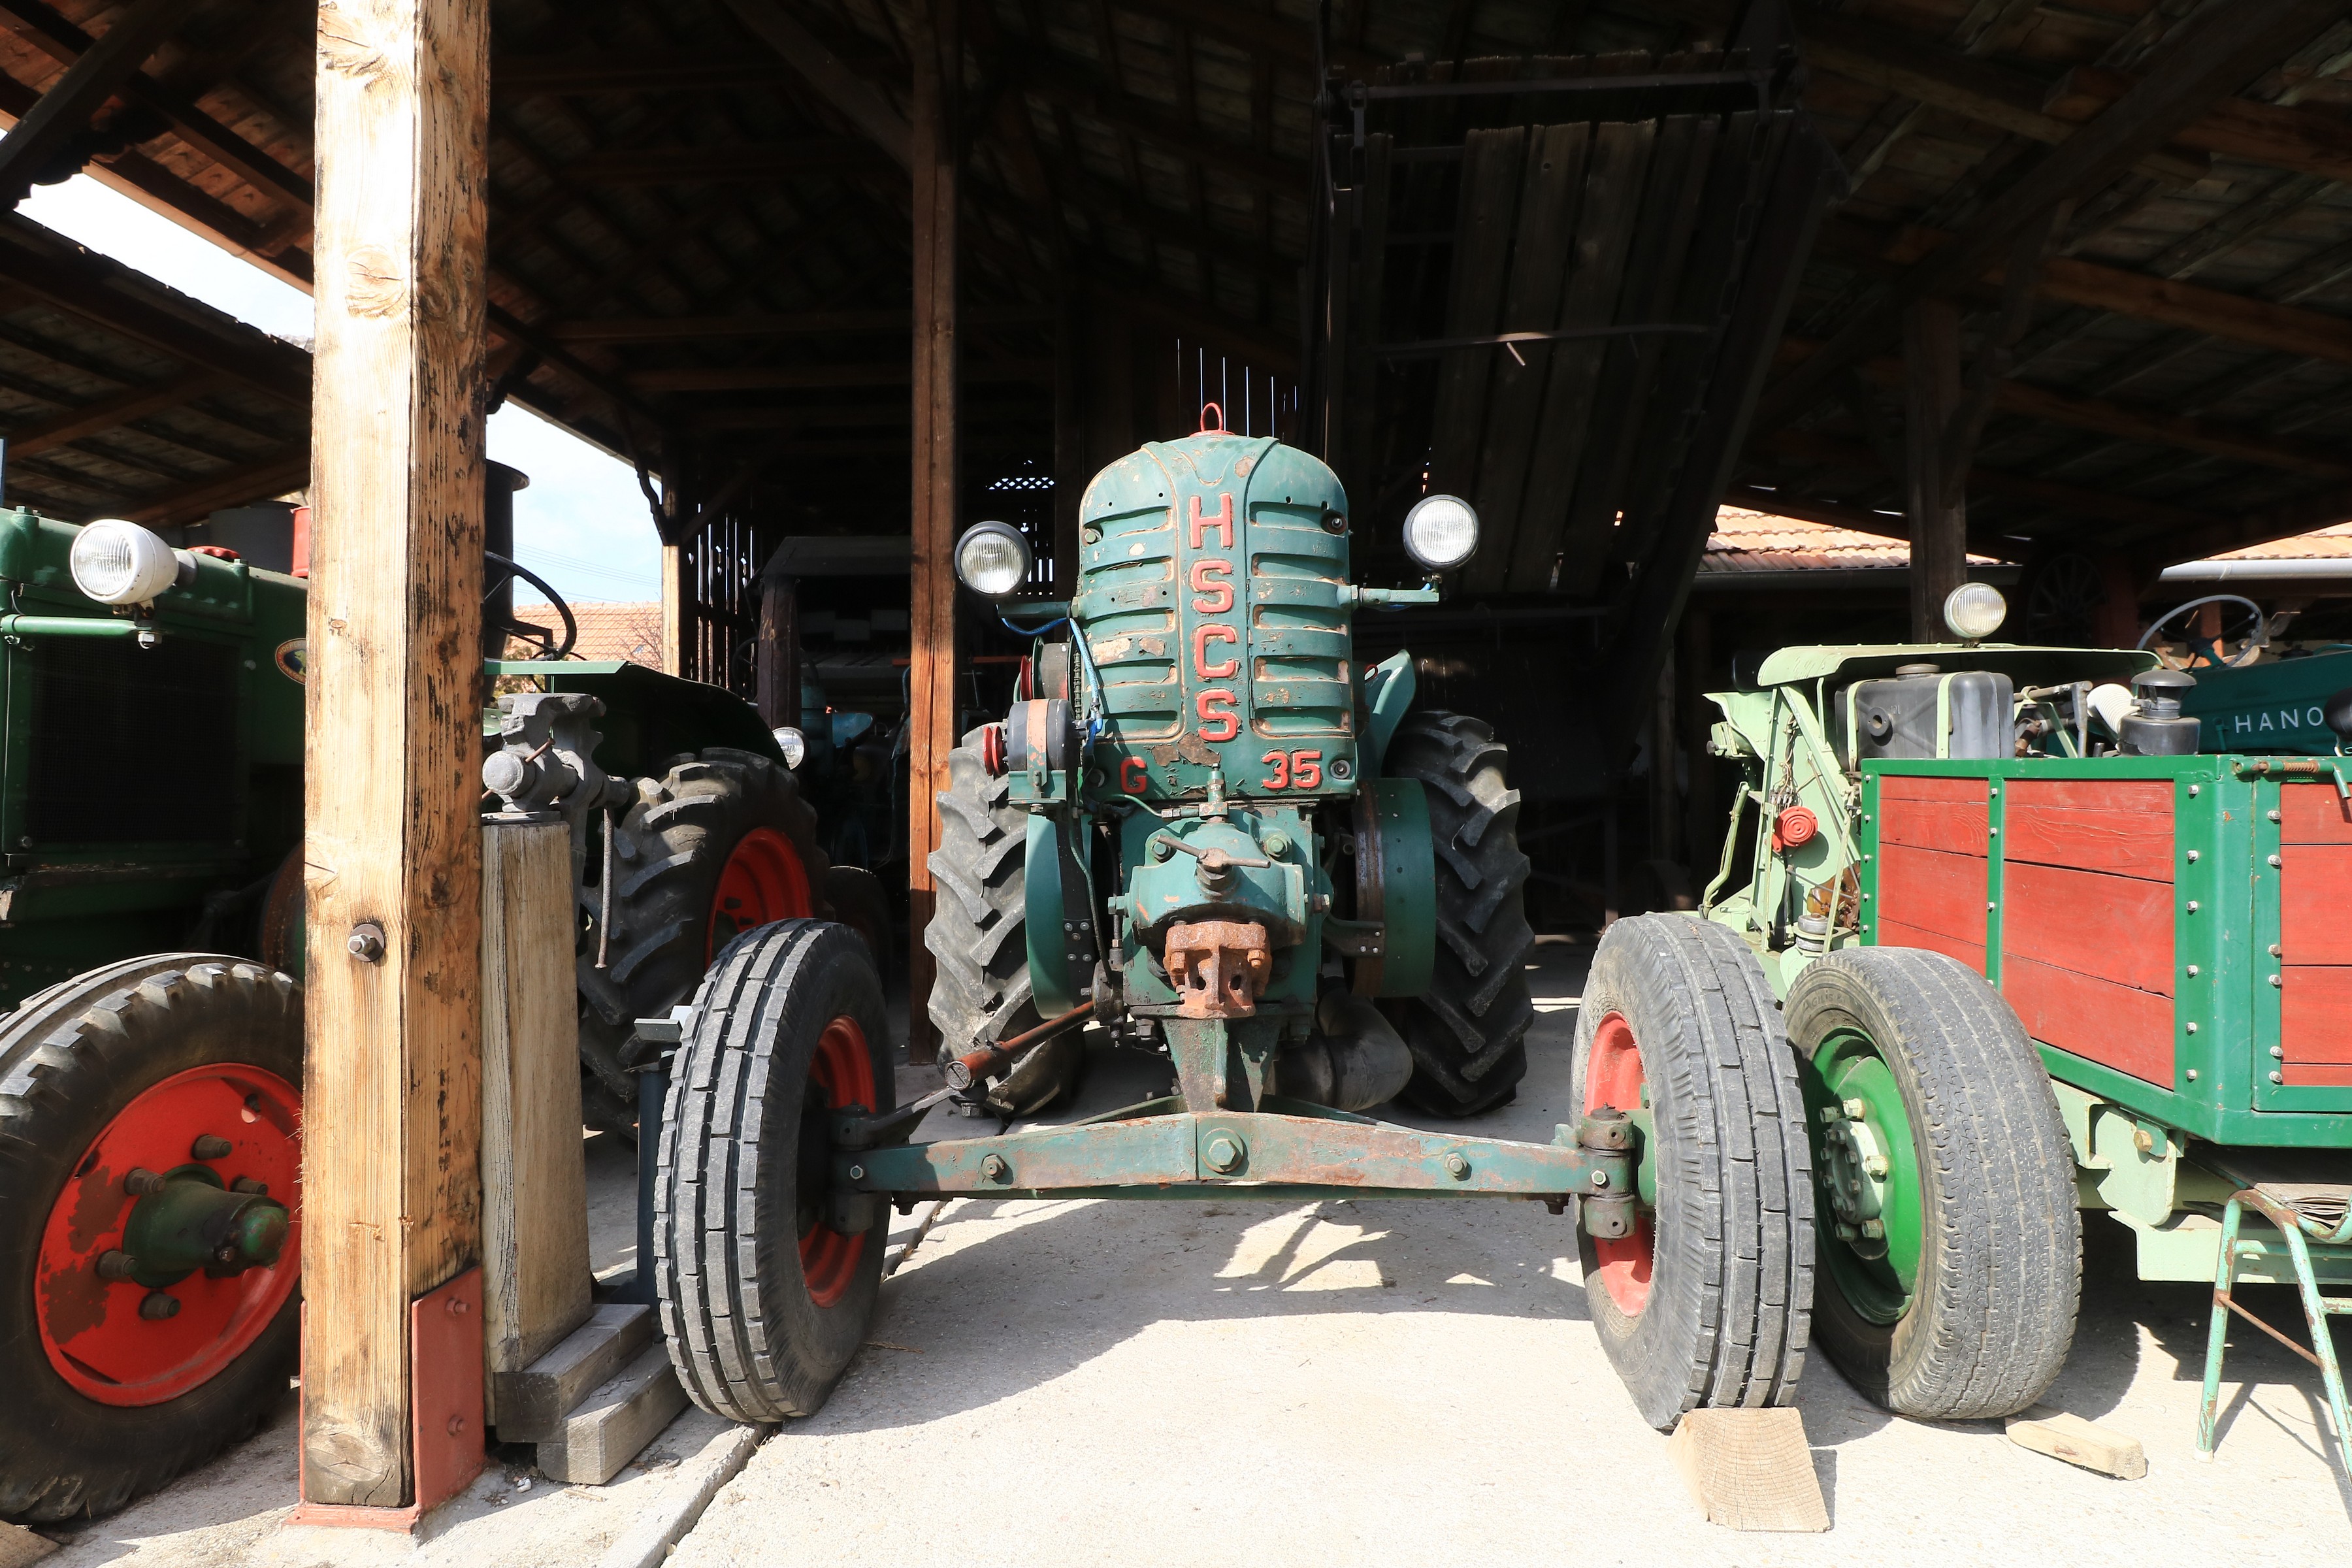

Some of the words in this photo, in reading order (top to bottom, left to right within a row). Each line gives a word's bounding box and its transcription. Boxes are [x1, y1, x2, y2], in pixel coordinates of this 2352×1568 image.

[1190, 493, 1237, 742] HSCS
[2235, 706, 2324, 734] HANO
[1120, 757, 1147, 793] G
[1262, 751, 1322, 789] 35
